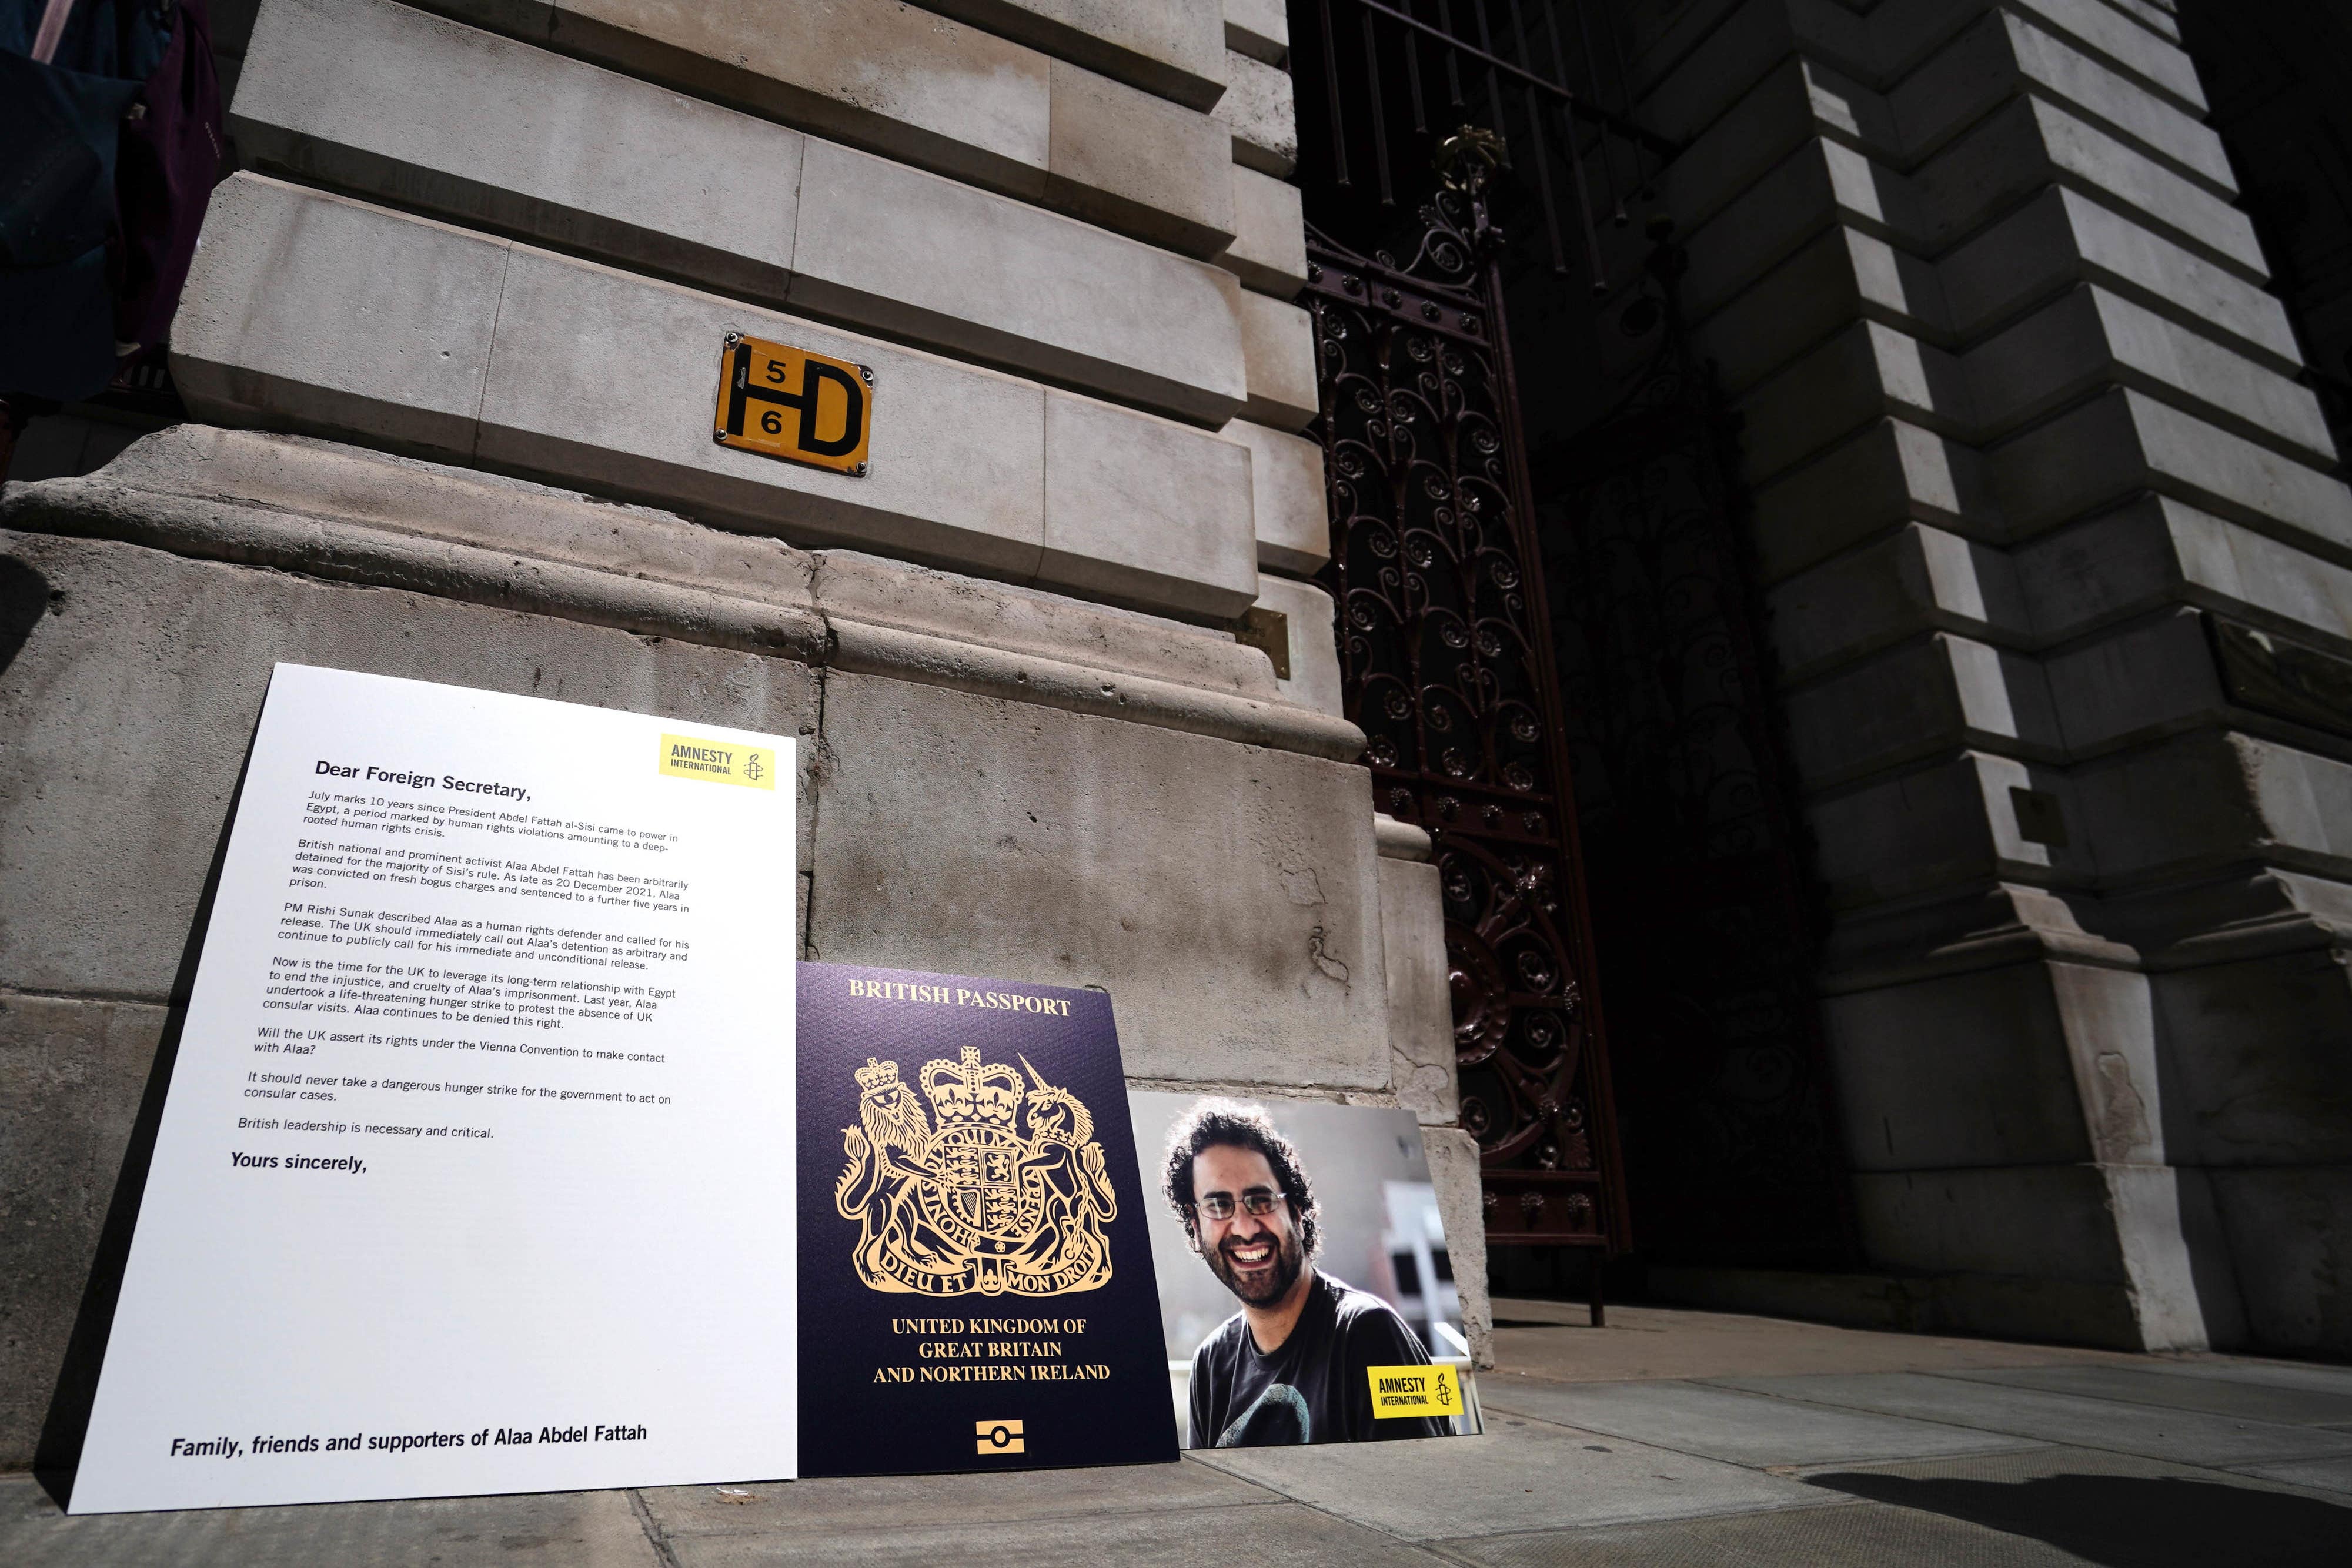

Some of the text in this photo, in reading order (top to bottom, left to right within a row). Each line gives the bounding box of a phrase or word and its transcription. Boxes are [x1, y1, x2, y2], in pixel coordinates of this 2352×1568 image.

[766, 360, 786, 384] 5
[727, 343, 863, 457] HD
[761, 410, 783, 434] 6
[670, 758, 732, 775] INTERNATIONAL
[671, 744, 733, 765] AMNESTY
[315, 760, 531, 802] Dear Foreign Secretary,
[303, 816, 445, 837] rooted human rights crisis.
[306, 802, 339, 815] Egypt,
[353, 809, 387, 819] period
[390, 813, 429, 824] marked
[433, 816, 445, 827] by
[448, 818, 483, 830] human
[486, 823, 515, 834] rights
[518, 827, 564, 840] violations
[567, 834, 619, 848] amounting
[622, 839, 631, 848] to
[642, 842, 669, 853] deep-
[308, 790, 678, 842] July marks 10 years since President Abdel Fattah al-Sisi came to power in
[298, 838, 689, 891] British national and prominent activist Alaa Abdel Fattah has been arbitrarily
[289, 877, 327, 888] prison.
[283, 902, 303, 913] PM
[307, 904, 336, 915] Rishi
[339, 907, 374, 919] Sunak
[377, 911, 431, 924] described
[433, 915, 457, 927] Alaa
[460, 920, 473, 928] as
[486, 921, 522, 932] human
[525, 924, 554, 936] rights
[557, 928, 602, 940] defender
[604, 934, 623, 942] and
[626, 935, 656, 946] called
[659, 938, 672, 947] for
[675, 940, 690, 950] his
[278, 931, 648, 970] continue to publicly call for his immediate and unconditional release.
[272, 956, 676, 999] Now is the time for the UK to leverage its long-term relationship with Egypt
[849, 979, 1071, 1017] BRITISH PASSPORT
[263, 1000, 564, 1029] consular visits. Alaa continues to be denied this right.
[254, 1042, 316, 1055] with Alaa?
[258, 1027, 666, 1063] Will the UK assert its rights under the Vienna Convention to make contact
[244, 1088, 336, 1101] consular cases.
[238, 1117, 493, 1138] British leadership is necessary and critical.
[231, 1151, 367, 1174] Yours sincerely,
[880, 1243, 1096, 1292] DIEU ET MON DROIT
[892, 1319, 1086, 1334] UNITED KINGDOM OF
[919, 1342, 1061, 1358] GREAT BRITAIN
[873, 1365, 1110, 1383] AND NORTHERN IRELAND
[1379, 1377, 1425, 1394] AMNESTY
[1381, 1395, 1429, 1406] INTERNATIONAL
[170, 1423, 647, 1459] Family, friends and supporters of Alaa Abdel Fattah
